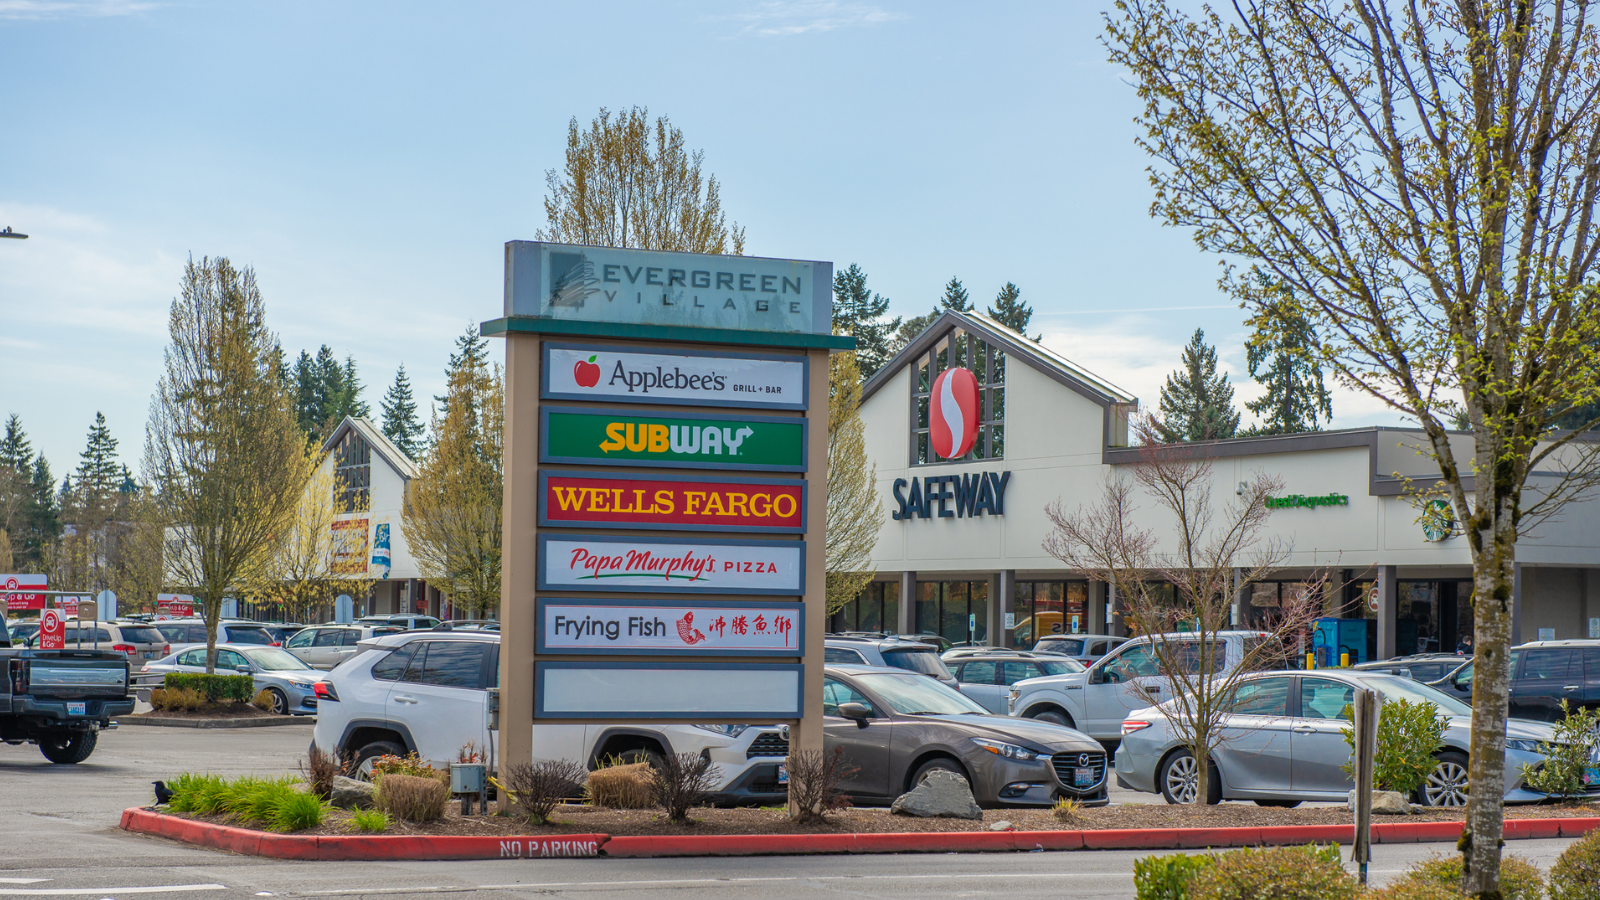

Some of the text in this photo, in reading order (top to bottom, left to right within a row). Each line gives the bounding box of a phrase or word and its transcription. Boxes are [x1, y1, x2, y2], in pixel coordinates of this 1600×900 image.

[603, 264, 801, 295] EVERGREEN
[604, 290, 801, 314] VILLAGE
[608, 359, 726, 393] Applebee's
[733, 384, 757, 393] GRILL
[765, 386, 782, 394] BAR
[599, 422, 754, 456] SUBWAY
[552, 486, 797, 518] WELLS FARGO
[892, 470, 1011, 521] SAFEWAY
[1292, 492, 1348, 509] Diagnostics
[570, 548, 777, 582] Papa Murphy's PIZZA
[554, 614, 667, 641] Frying Fish
[500, 841, 597, 857] NO PARKING
